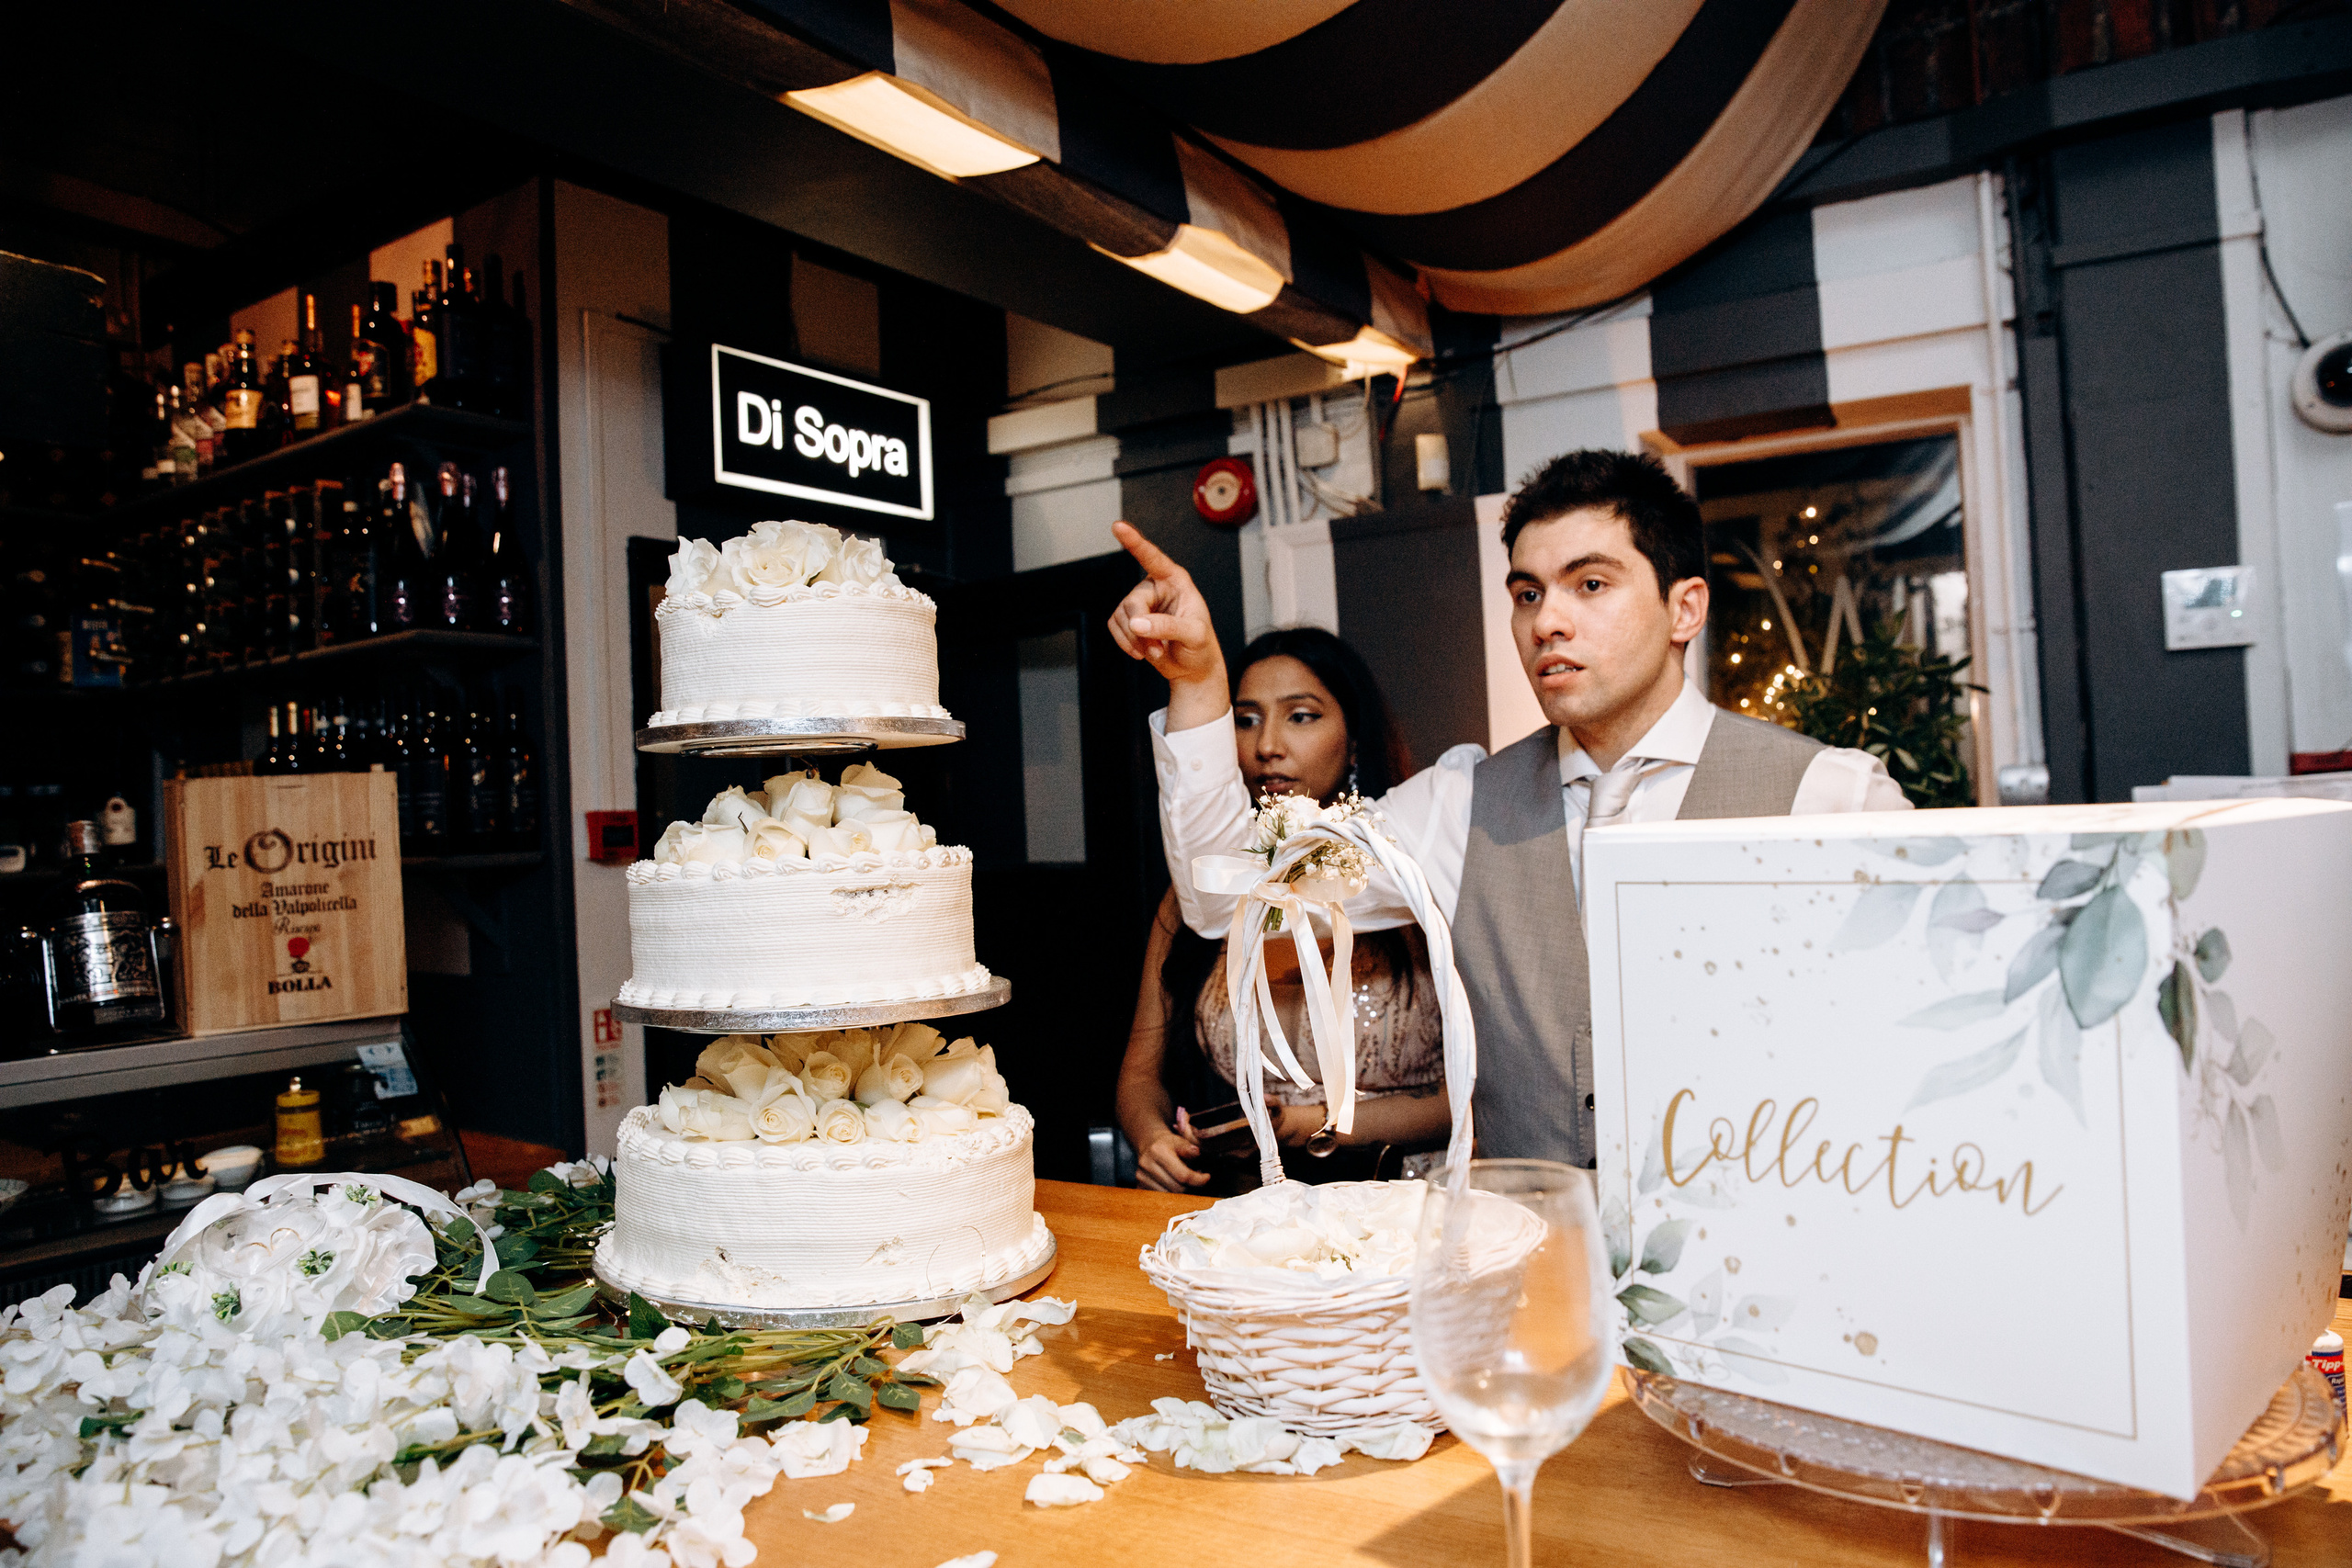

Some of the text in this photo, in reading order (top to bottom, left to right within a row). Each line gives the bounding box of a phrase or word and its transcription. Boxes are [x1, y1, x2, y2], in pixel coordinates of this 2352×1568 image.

[738, 390, 909, 478] Di Sopra
[204, 828, 376, 874] Le Origini
[232, 896, 357, 918] della Valpolicella
[261, 881, 330, 897] Amarone
[267, 976, 333, 995] BOLLA
[44, 1132, 208, 1200] Bar
[1663, 1089, 2064, 1215] Collection
